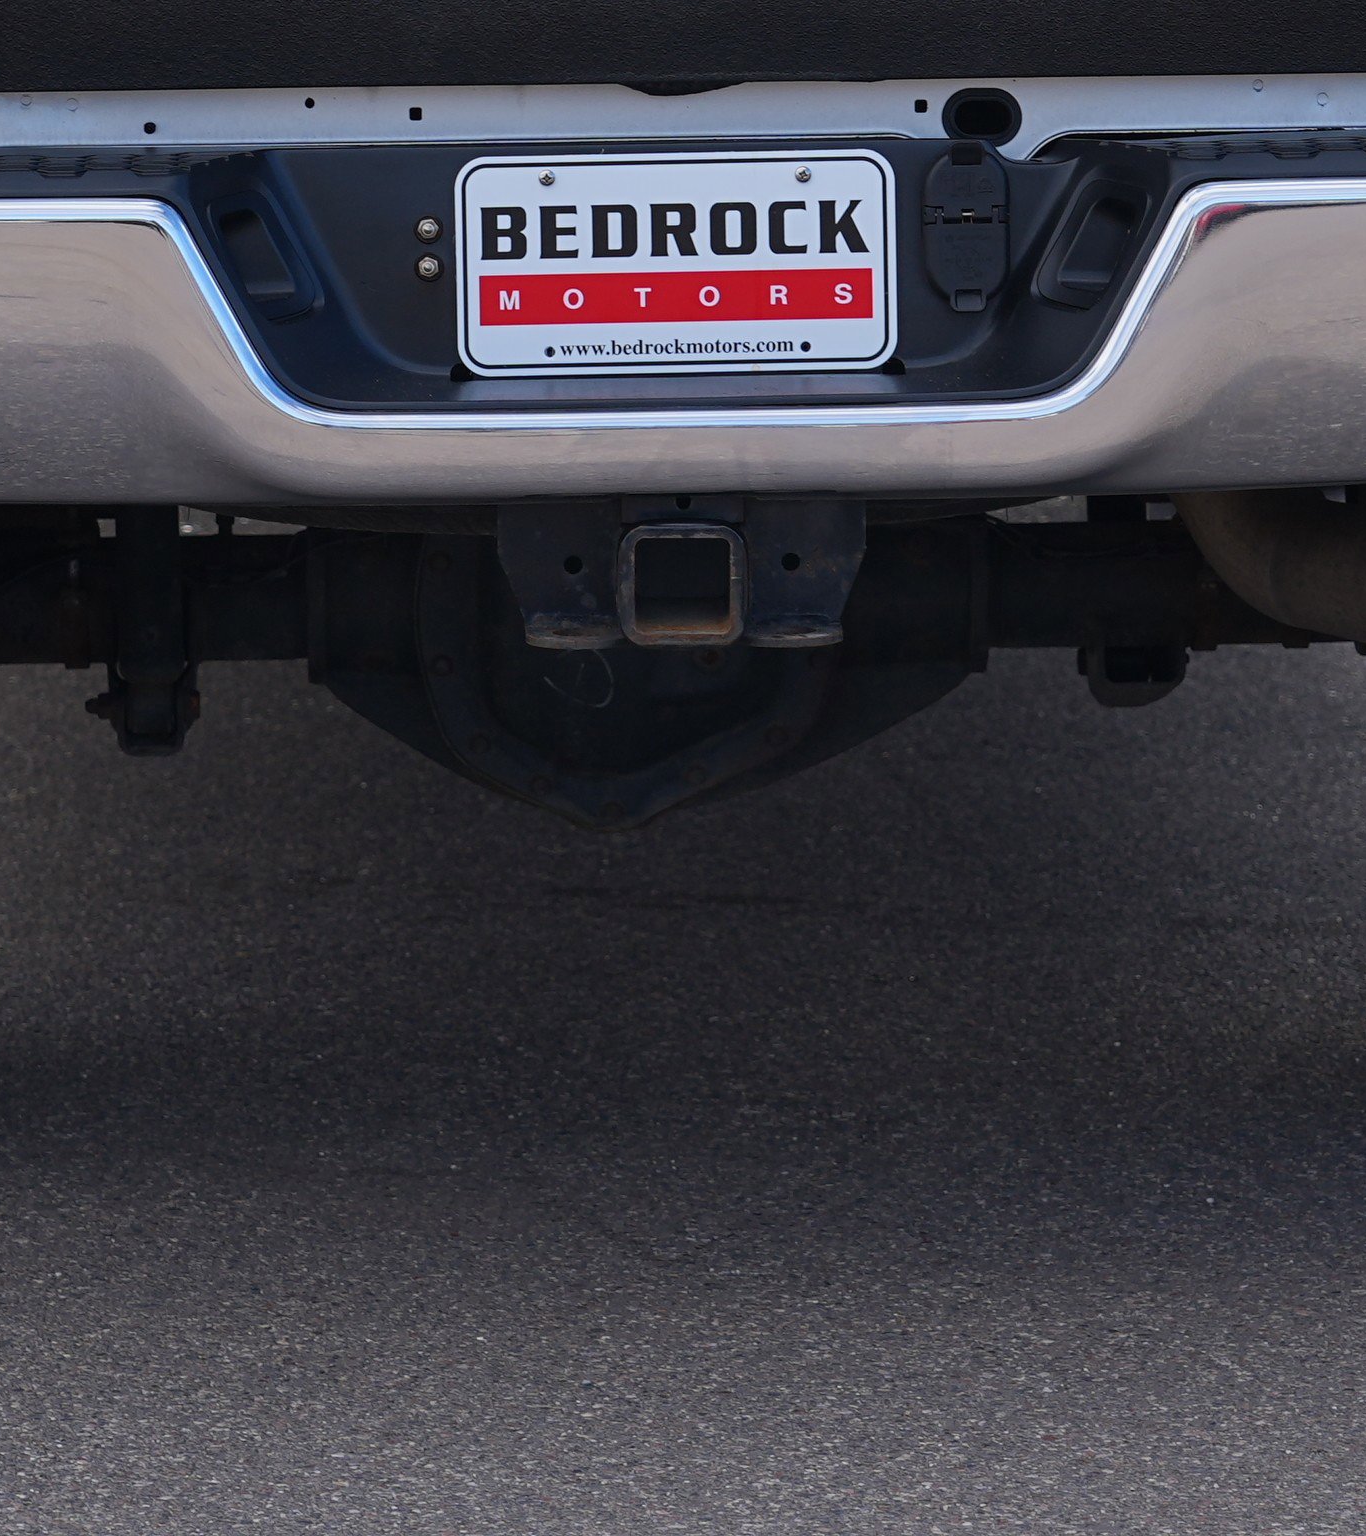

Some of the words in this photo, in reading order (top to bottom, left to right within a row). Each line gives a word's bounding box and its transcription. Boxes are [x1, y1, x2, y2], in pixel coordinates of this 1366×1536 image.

[480, 199, 870, 260] BEDROCK
[498, 283, 854, 311] MOTORS
[559, 338, 795, 357] www.bedrockmotors.com
